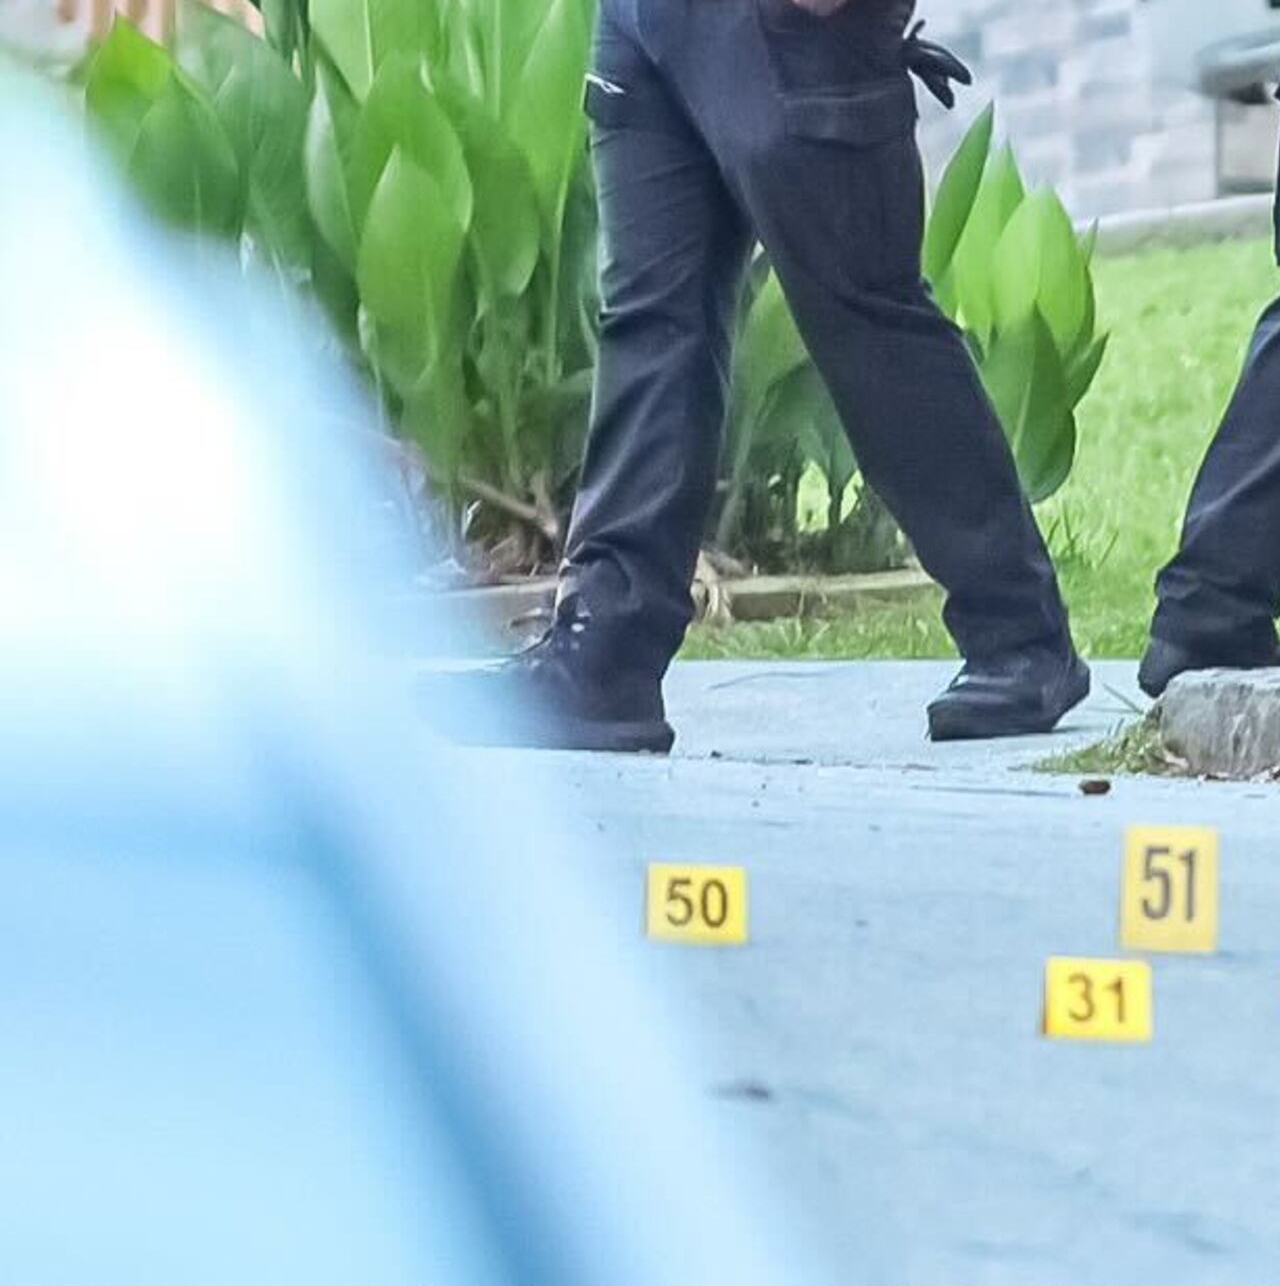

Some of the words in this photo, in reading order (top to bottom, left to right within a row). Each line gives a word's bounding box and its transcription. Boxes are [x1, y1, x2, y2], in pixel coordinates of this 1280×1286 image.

[664, 876, 730, 929] 50
[1140, 845, 1199, 923] 51
[1066, 972, 1127, 1024] 31
